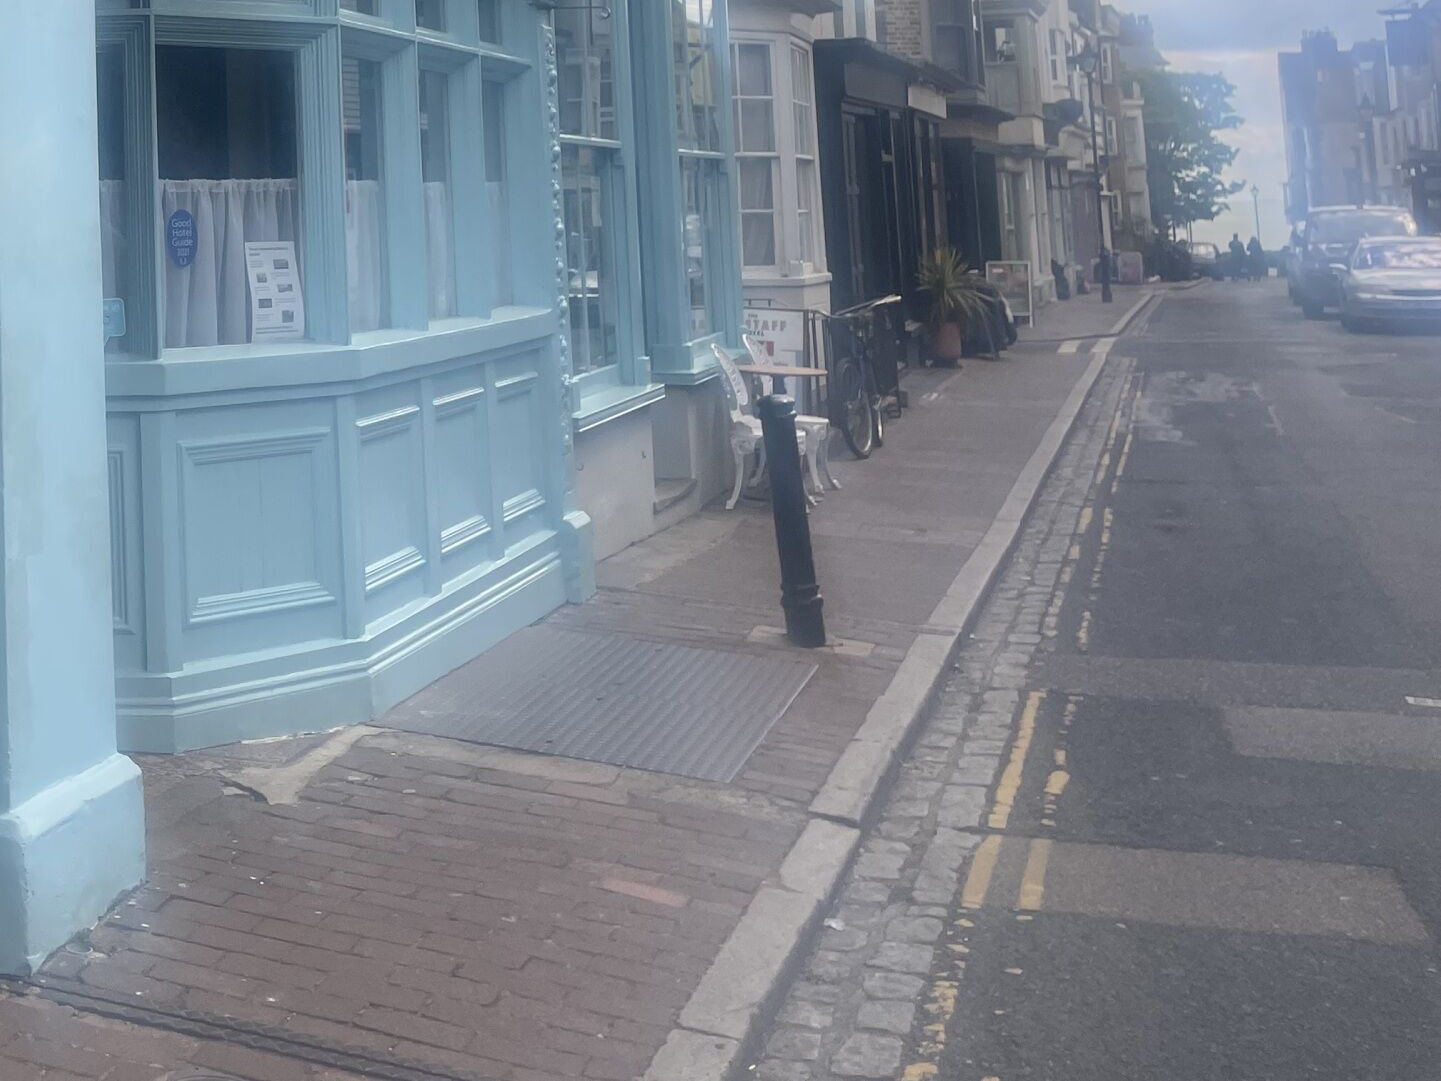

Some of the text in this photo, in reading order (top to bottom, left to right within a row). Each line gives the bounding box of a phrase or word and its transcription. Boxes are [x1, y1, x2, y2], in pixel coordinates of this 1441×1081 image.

[171, 218, 192, 228] Good
[172, 228, 193, 237] Hotel
[171, 238, 194, 247] Guide
